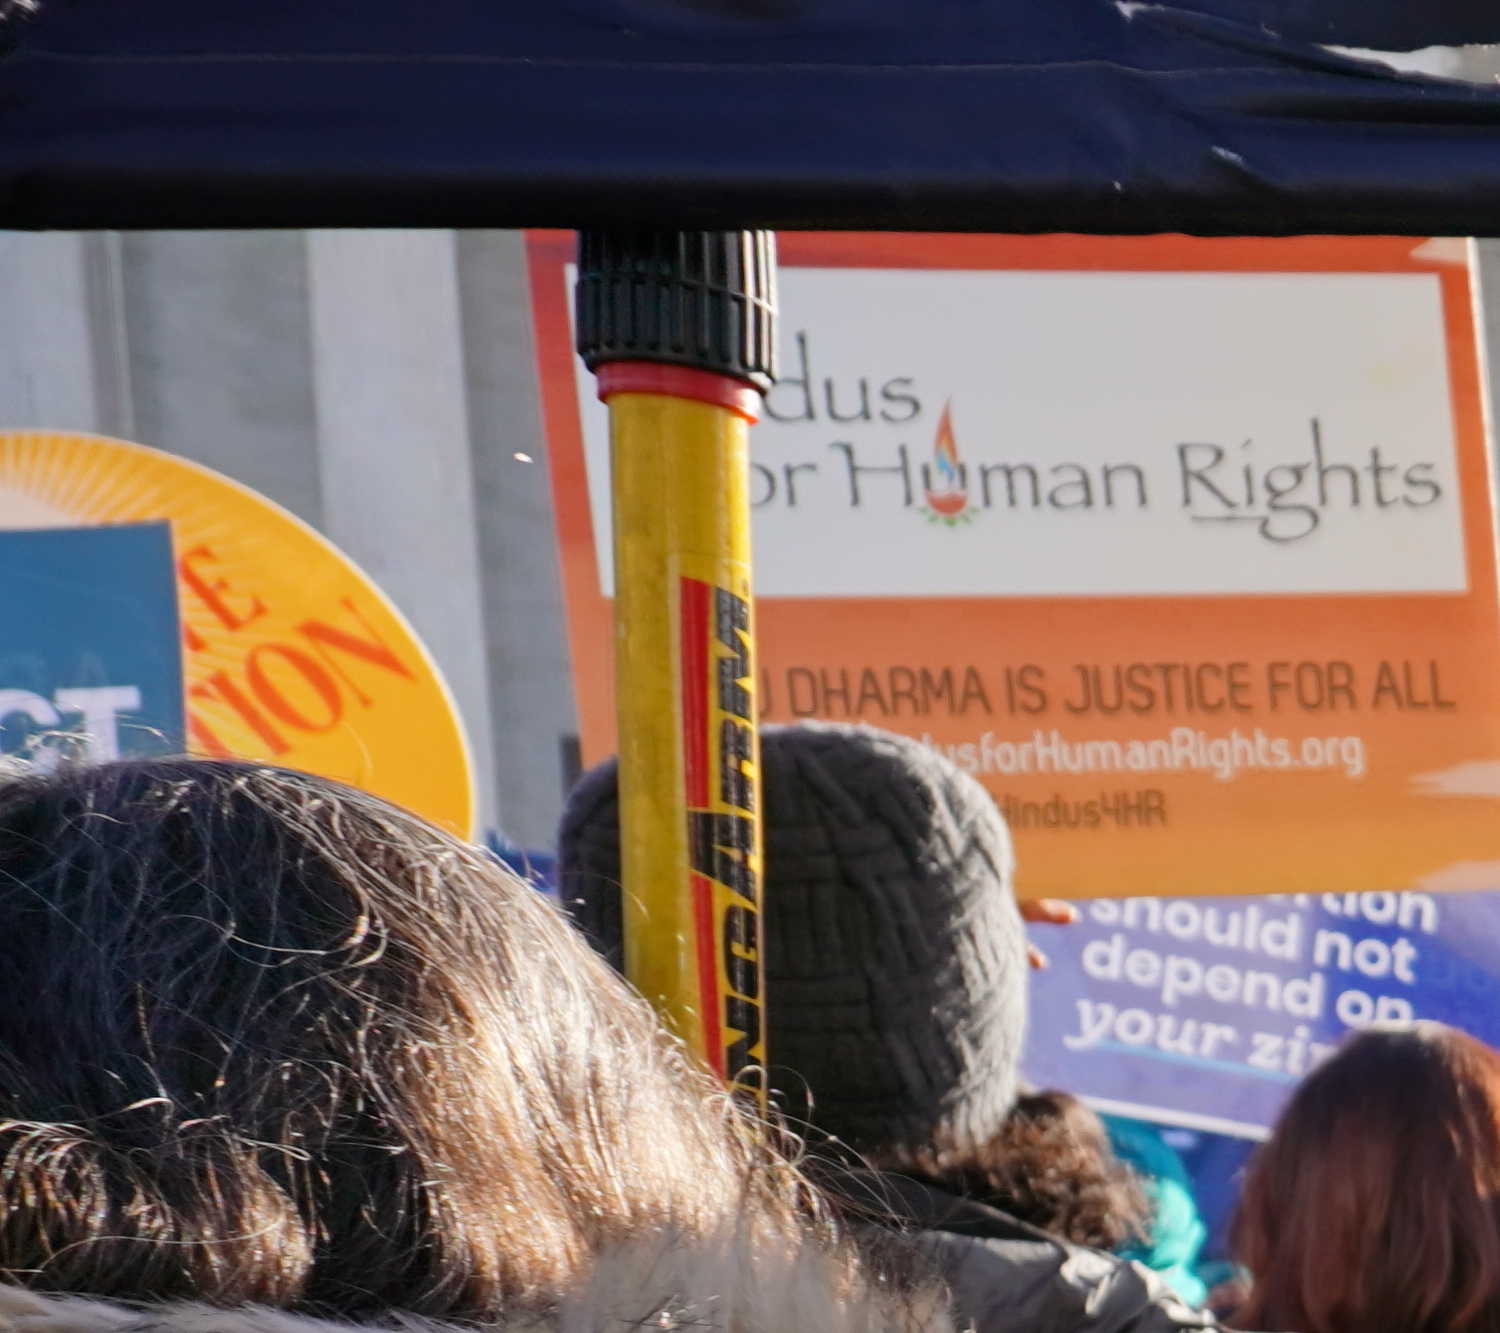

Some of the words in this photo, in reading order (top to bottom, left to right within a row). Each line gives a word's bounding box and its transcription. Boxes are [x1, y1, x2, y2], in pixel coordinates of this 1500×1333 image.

[828, 440, 1148, 510] Human
[1176, 418, 1442, 543] Rights
[787, 665, 992, 717] DHARMA
[1005, 664, 1048, 716] IS
[1065, 661, 1254, 714] JUSTICE
[1267, 661, 1357, 711] FOR
[1372, 659, 1457, 711] ALL
[1082, 932, 1326, 1019] depend
[1315, 936, 1417, 985] not
[1063, 998, 1239, 1058] your
